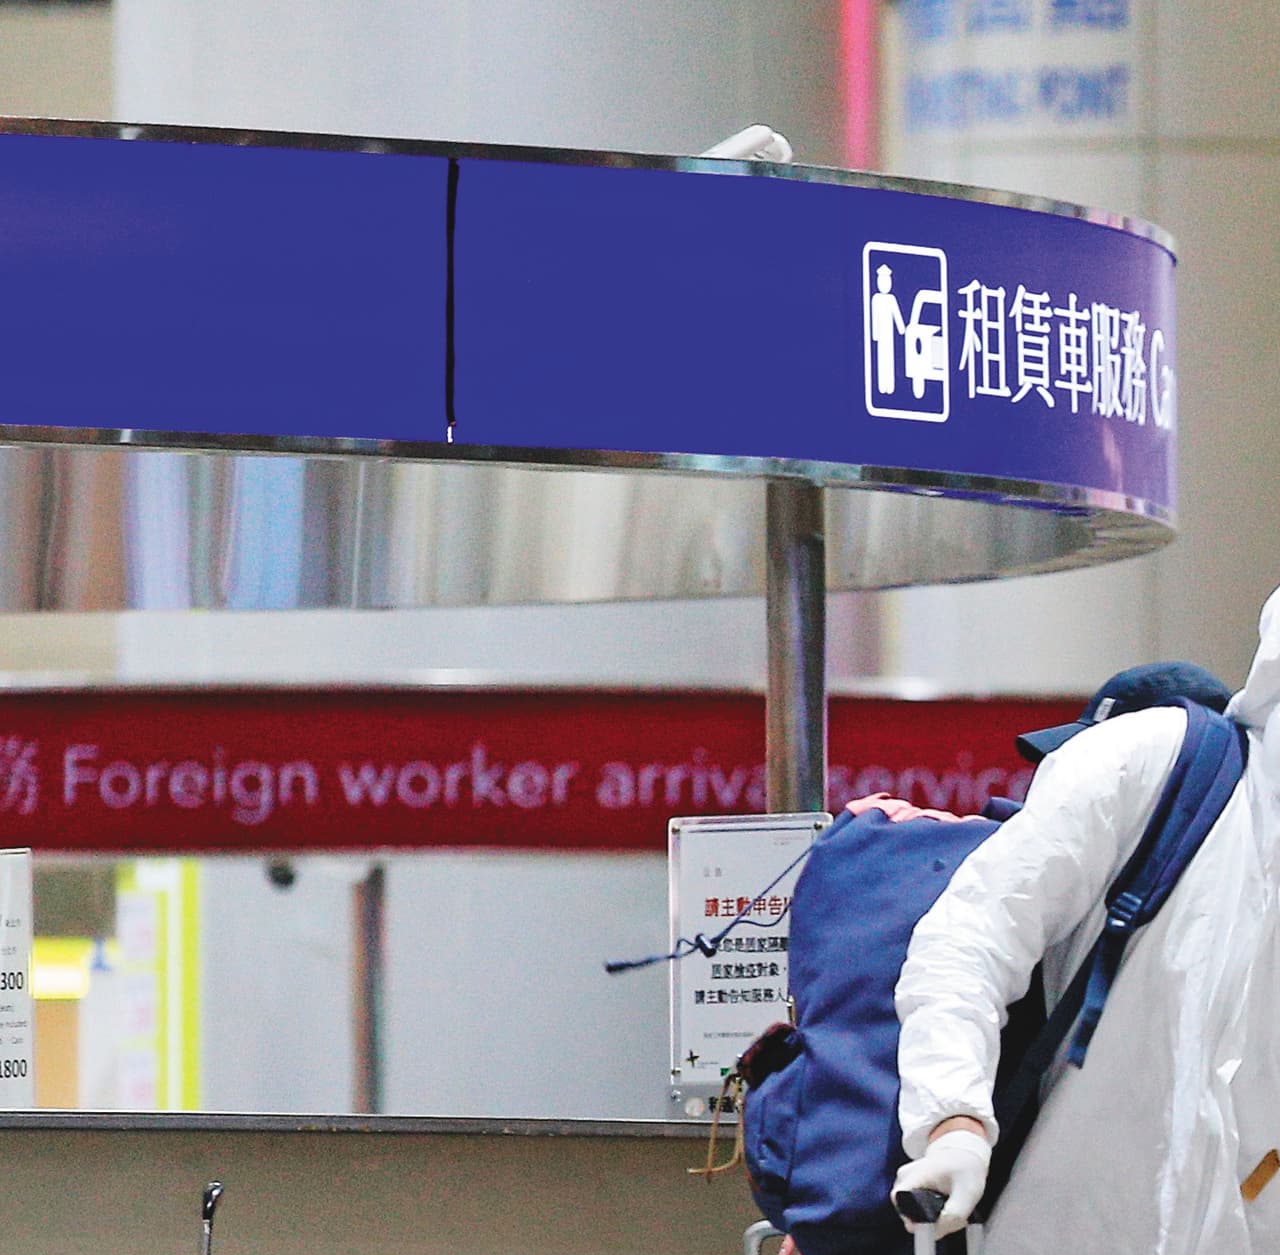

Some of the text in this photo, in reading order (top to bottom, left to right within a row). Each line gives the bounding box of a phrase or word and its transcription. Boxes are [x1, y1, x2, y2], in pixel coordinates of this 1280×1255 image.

[957, 279, 1147, 426] 租賃車服務
[63, 744, 319, 825] Foreign
[339, 742, 579, 808] worker
[595, 747, 768, 809] arriva
